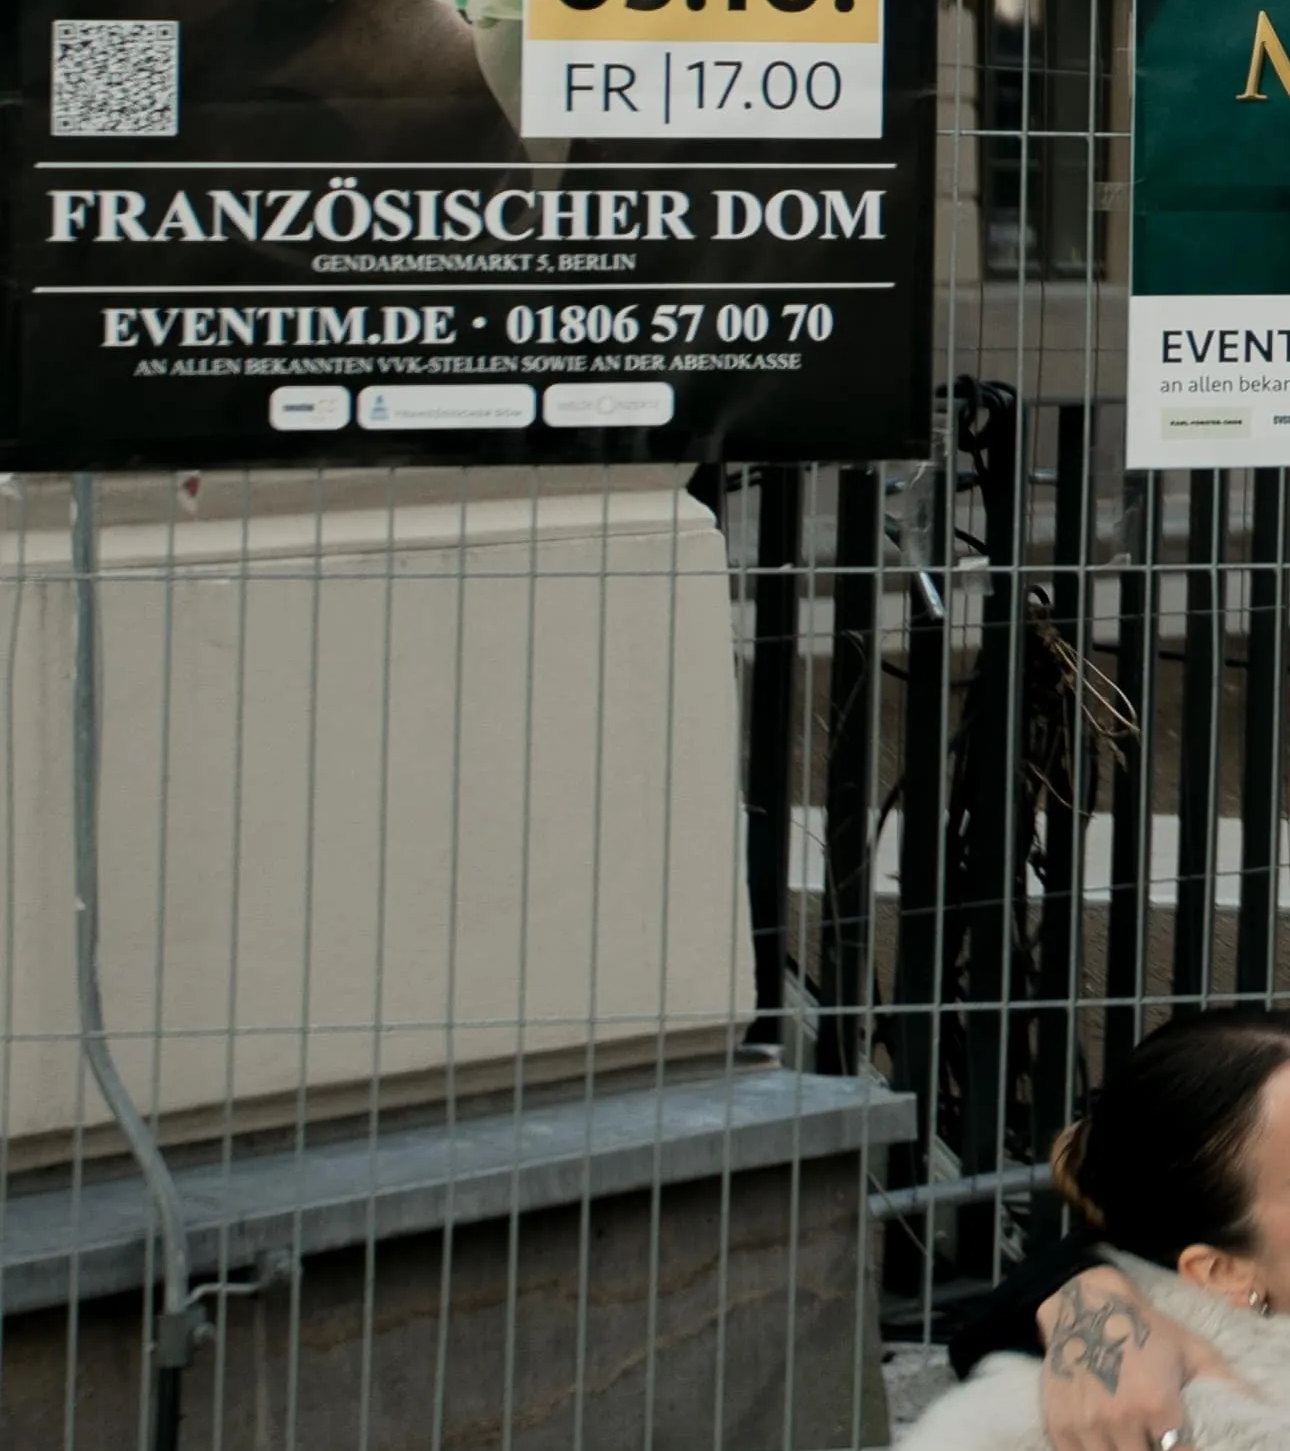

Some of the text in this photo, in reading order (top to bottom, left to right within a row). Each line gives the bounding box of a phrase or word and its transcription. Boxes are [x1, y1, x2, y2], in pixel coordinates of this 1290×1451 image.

[566, 60, 842, 112] FR 17.00
[48, 178, 886, 242] FRANZÖSISCHER DOM
[312, 253, 636, 272] GENDARMENMARKT 5, BERLIN
[102, 303, 834, 347] EVENTIM.DE 01806 57 00 70
[136, 353, 801, 376] AN ALLEN BEKANNTEN VVK-STELLEN SOWIE AN DER ABENDKASSE
[1160, 380, 1183, 393] an
[1188, 376, 1233, 393] allen
